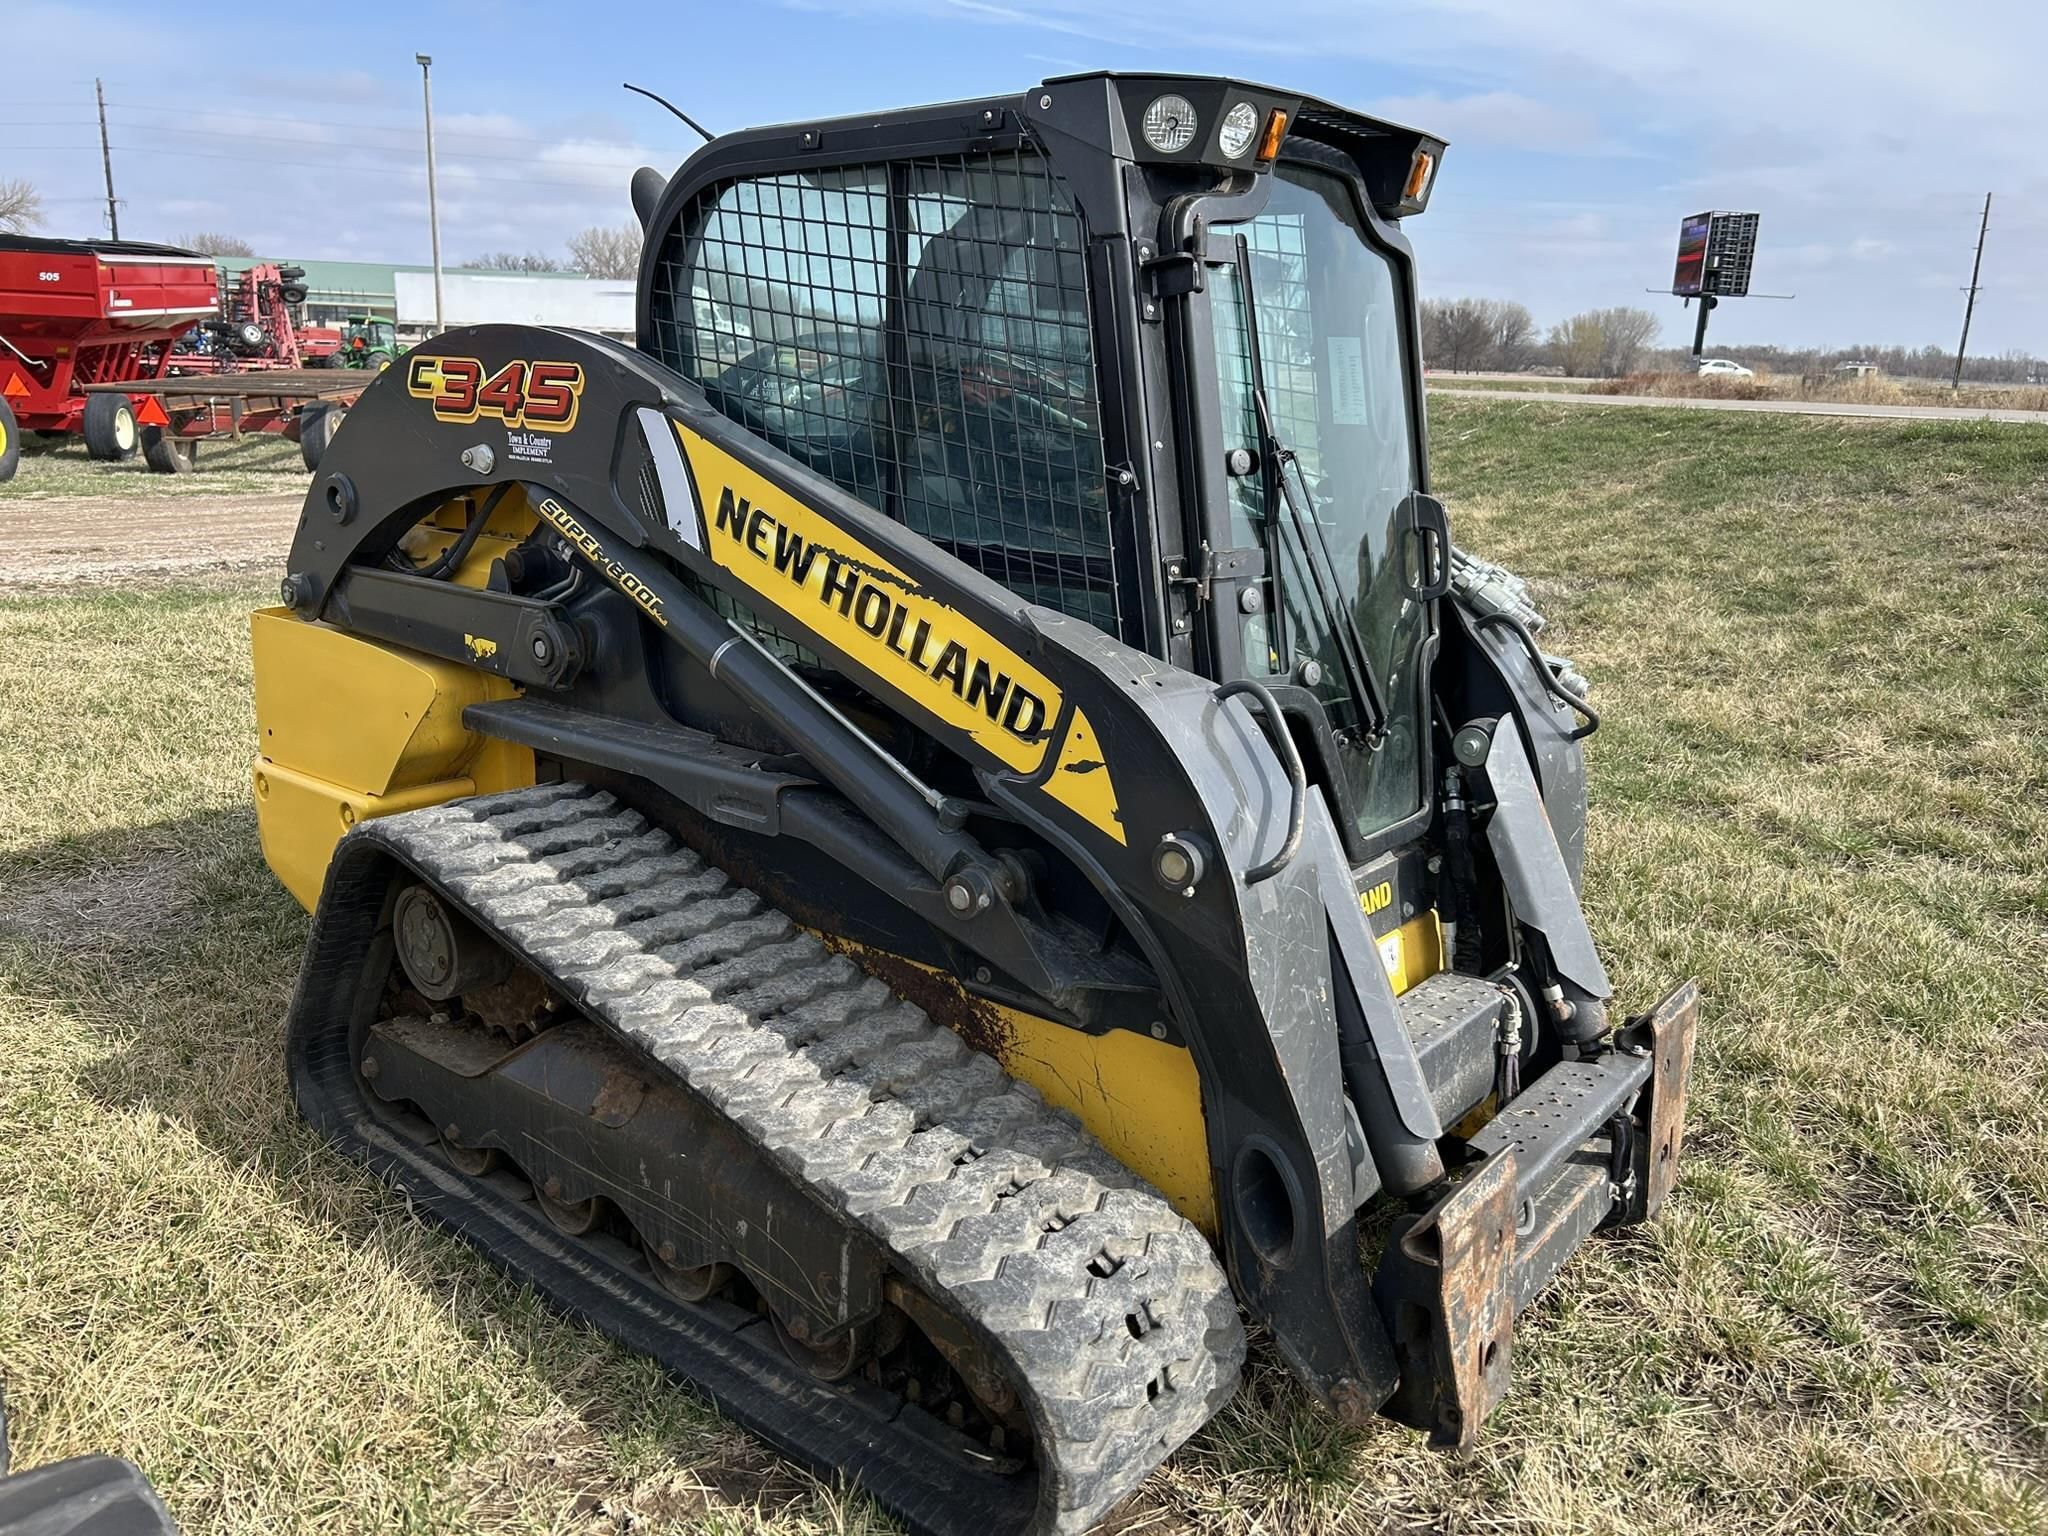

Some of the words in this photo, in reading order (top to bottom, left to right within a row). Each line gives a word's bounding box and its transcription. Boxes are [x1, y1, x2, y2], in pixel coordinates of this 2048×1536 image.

[39, 272, 60, 282] 505
[507, 431, 522, 444] Town
[523, 433, 528, 445] &
[529, 433, 552, 450] Country
[512, 446, 548, 457] IMPLEMENT
[714, 485, 815, 588] NEW
[818, 555, 1048, 744] HOLLAND
